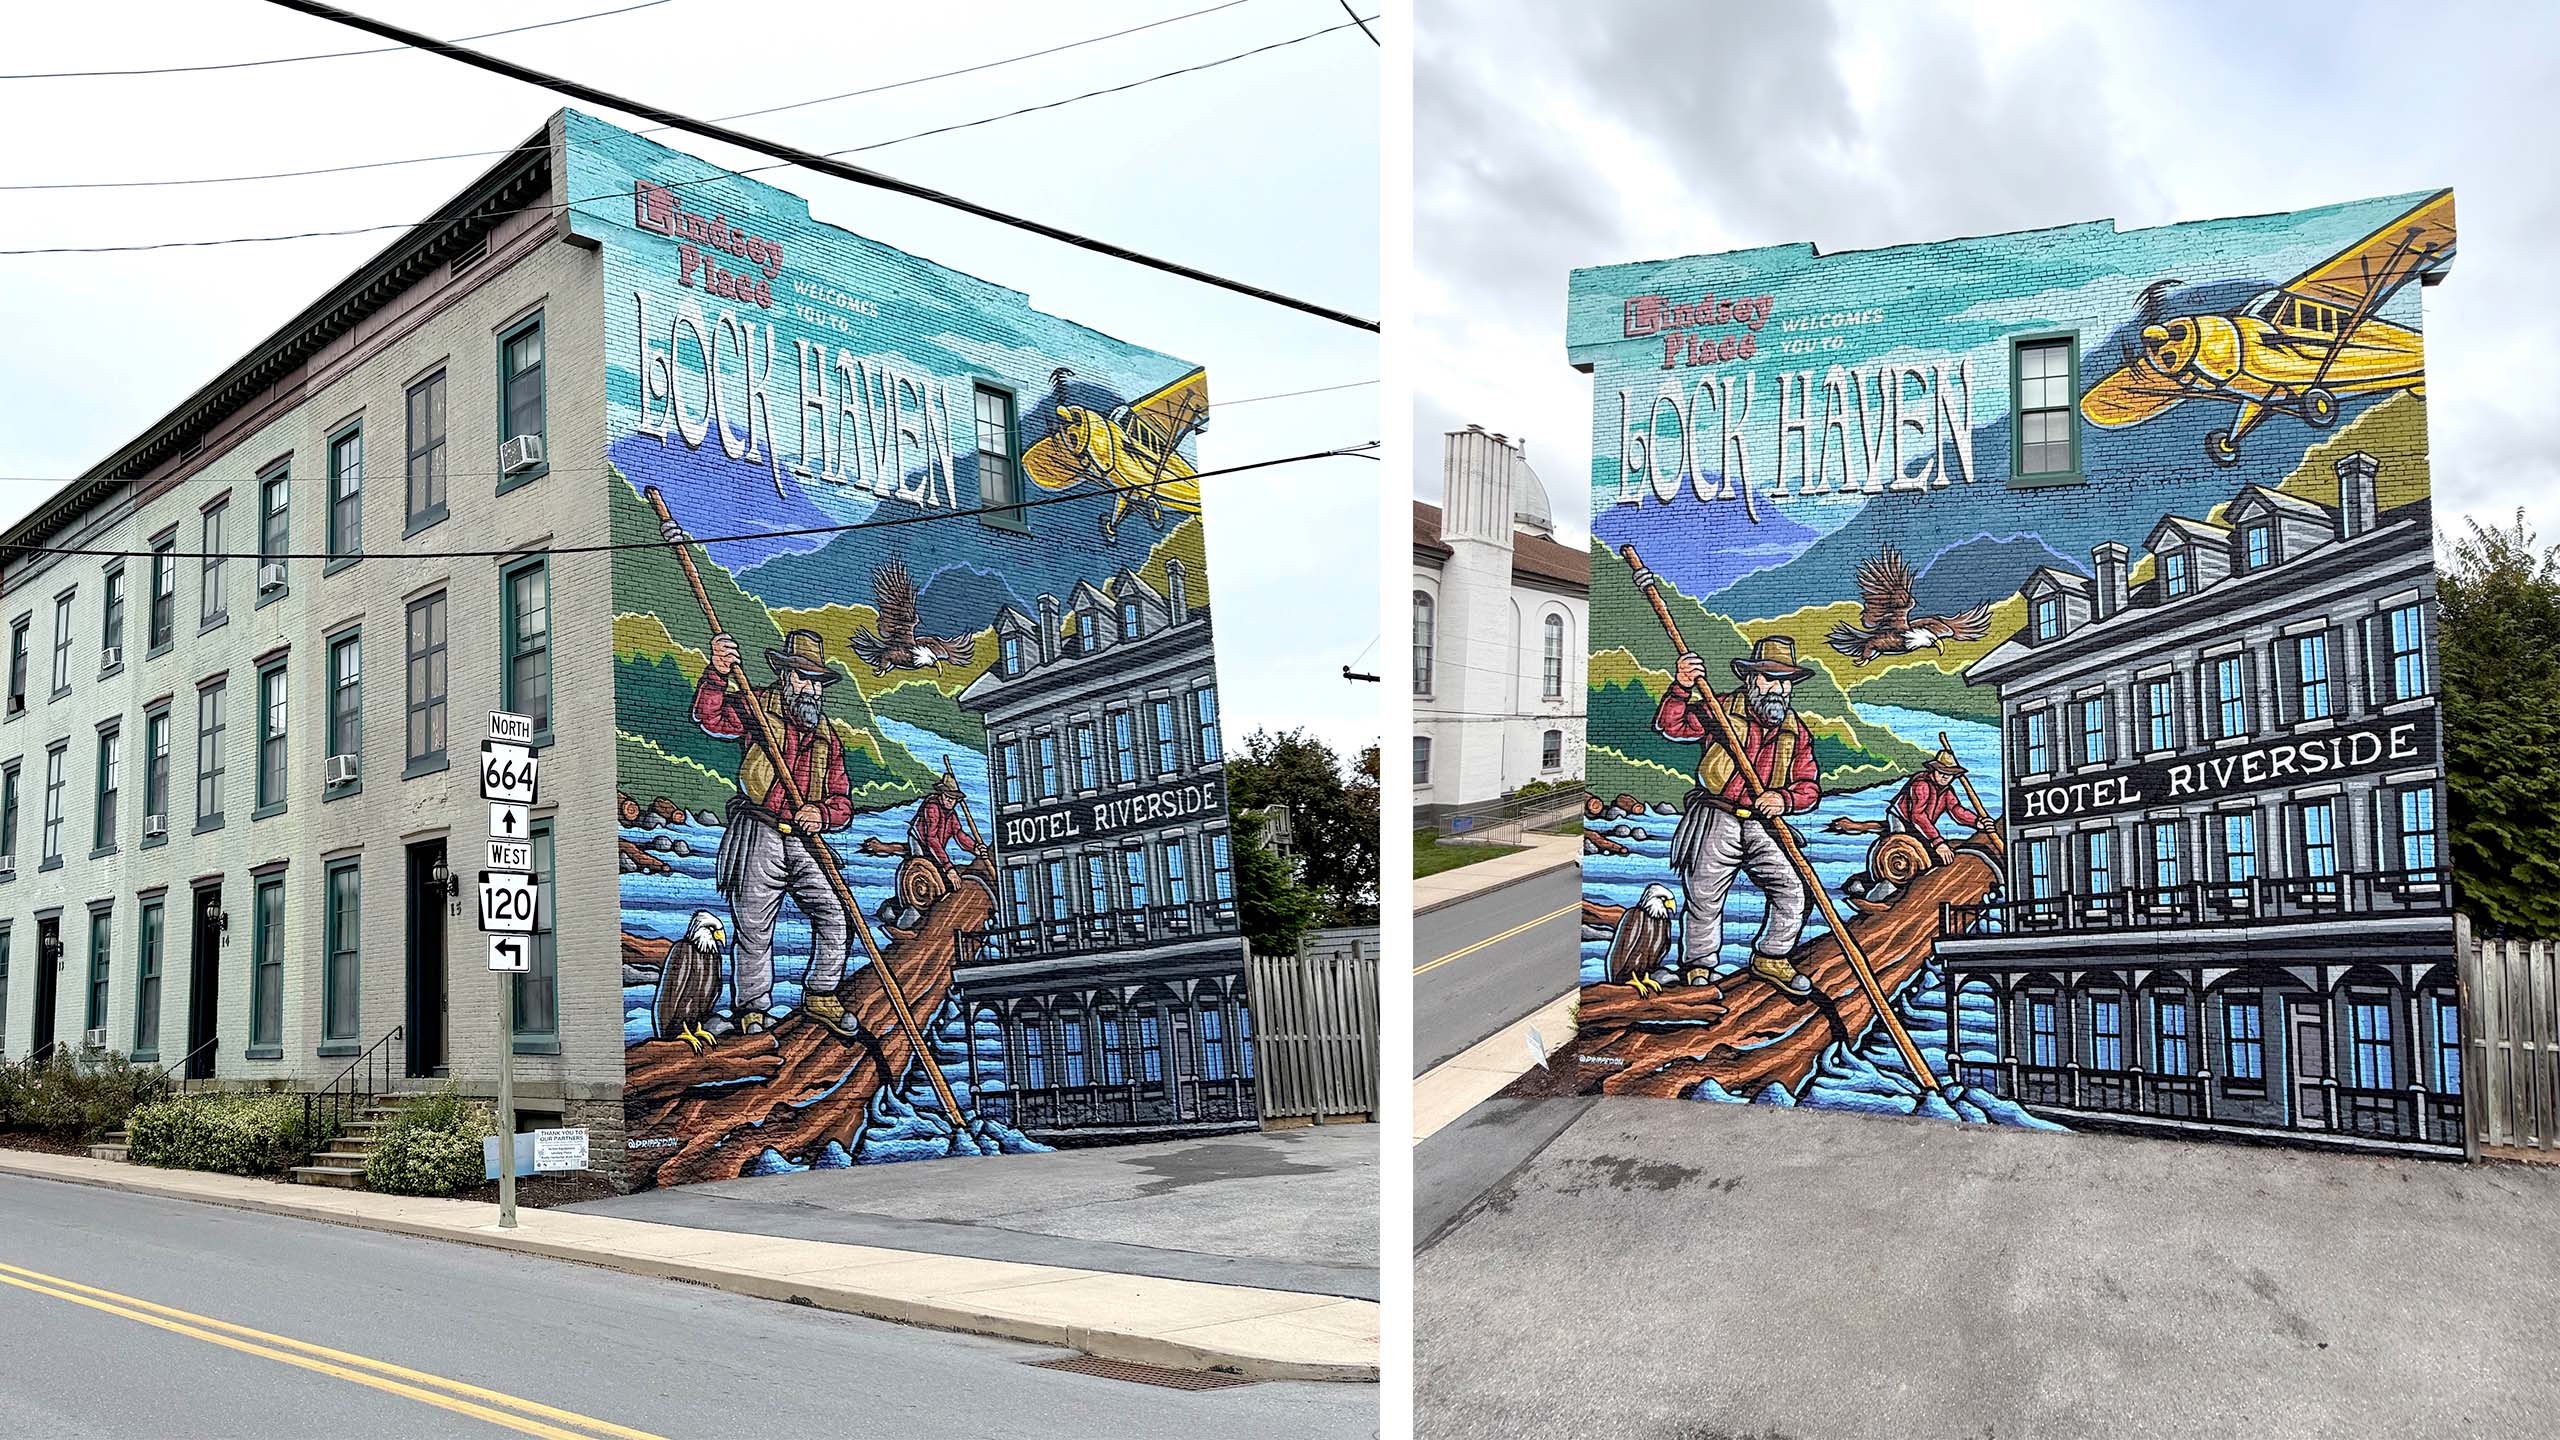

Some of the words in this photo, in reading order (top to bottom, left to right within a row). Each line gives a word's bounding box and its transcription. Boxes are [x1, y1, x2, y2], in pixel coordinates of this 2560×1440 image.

[634, 179, 785, 280] Lindsey
[676, 243, 775, 309] Place
[793, 279, 879, 319] WELCOMES
[794, 303, 827, 326] YOU
[1624, 293, 1775, 338] Lindsey
[1781, 307, 1885, 333] WELCOMES
[1661, 332, 1757, 370] Place
[1780, 339, 1817, 354] YOU
[634, 292, 787, 498] LOCK
[792, 337, 957, 510] HAVEN
[1616, 369, 1760, 524] LOCK
[1769, 358, 1975, 498] HAVEN
[491, 716, 530, 738] NORTH
[486, 758, 532, 792] 664
[2023, 776, 2141, 818] HOTEL
[2168, 723, 2418, 796] RIVERSIDE
[1006, 810, 1080, 845] HOTEL
[1093, 782, 1218, 831] RIVERSIDE
[491, 845, 527, 865] WEST
[450, 901, 462, 917] 15
[485, 888, 531, 920] 120
